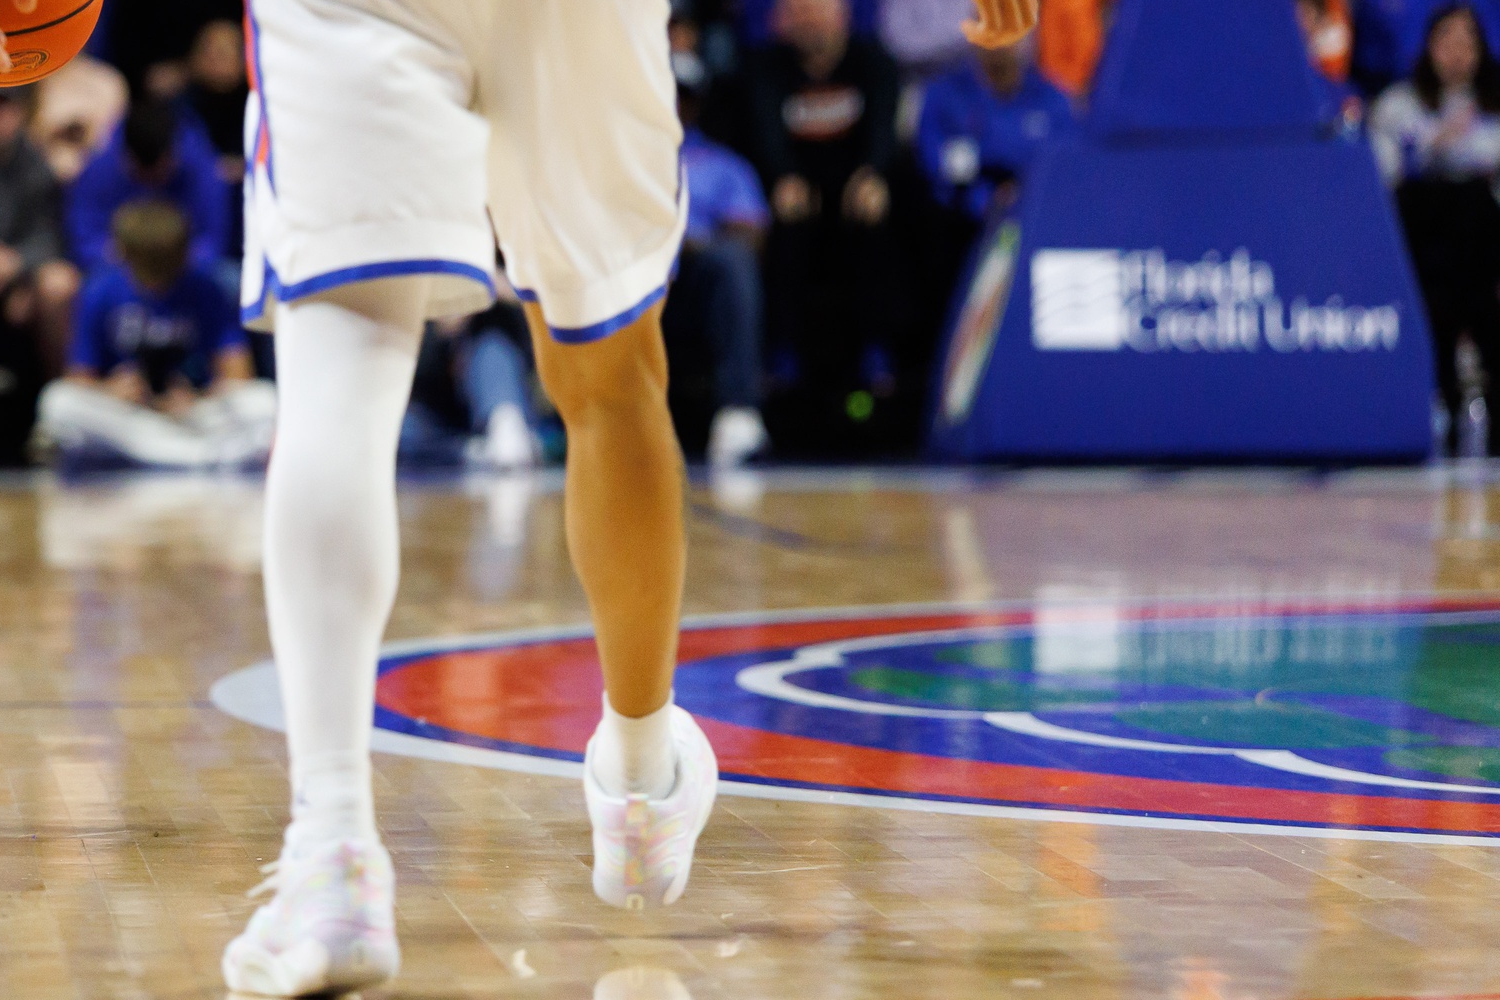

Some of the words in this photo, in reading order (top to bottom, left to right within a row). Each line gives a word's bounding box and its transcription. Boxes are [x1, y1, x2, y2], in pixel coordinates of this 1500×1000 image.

[1122, 245, 1275, 303] Florida
[1124, 296, 1260, 354] Credit
[1263, 294, 1400, 354] Union
